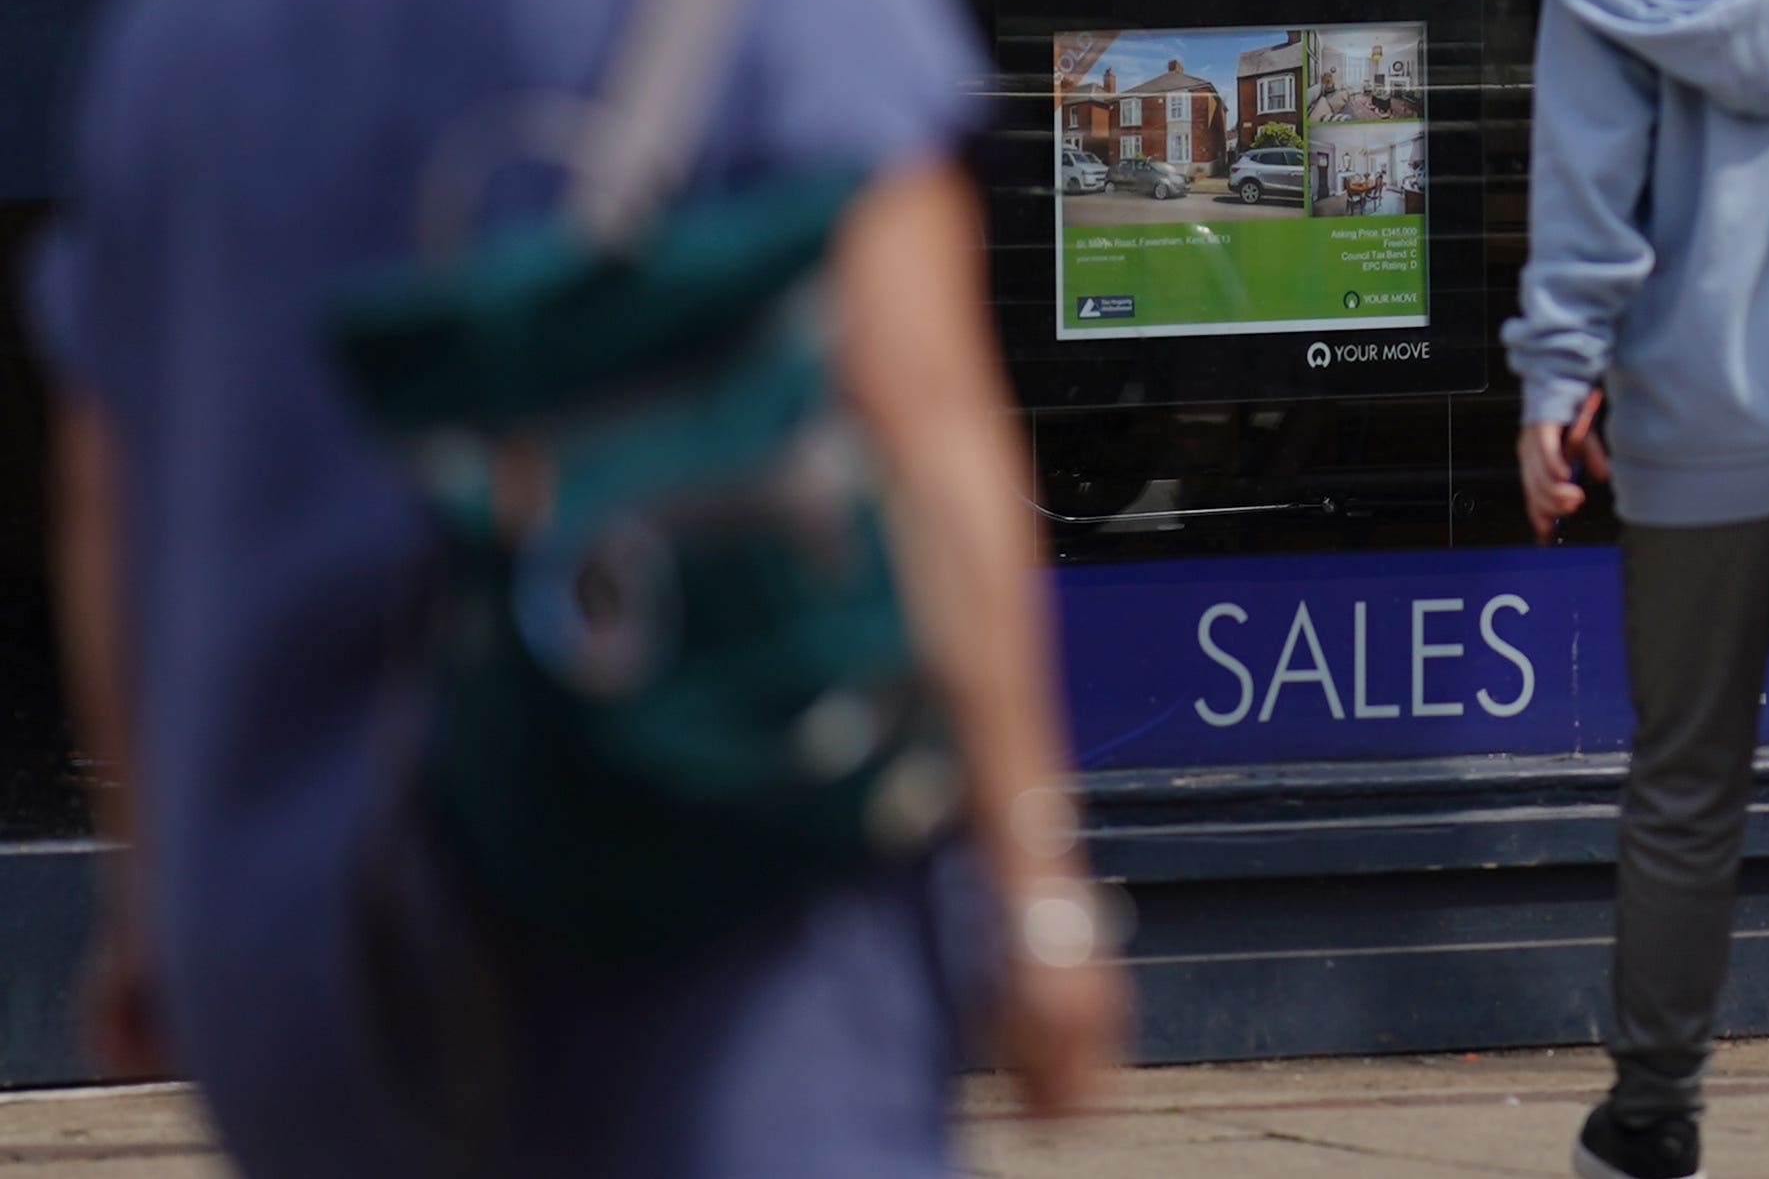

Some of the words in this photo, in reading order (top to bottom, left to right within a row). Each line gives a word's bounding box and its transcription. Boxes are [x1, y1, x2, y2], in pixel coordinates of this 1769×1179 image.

[1330, 229, 1357, 240] Asking
[1383, 238, 1417, 247] Freehold
[1341, 251, 1370, 261] Council
[1372, 251, 1385, 260] Tax
[1363, 293, 1389, 304] YOUR
[1391, 292, 1417, 303] MOVE
[1334, 344, 1378, 362] YOUR
[1382, 341, 1431, 360] MOVE
[1195, 593, 1536, 727] SALES
